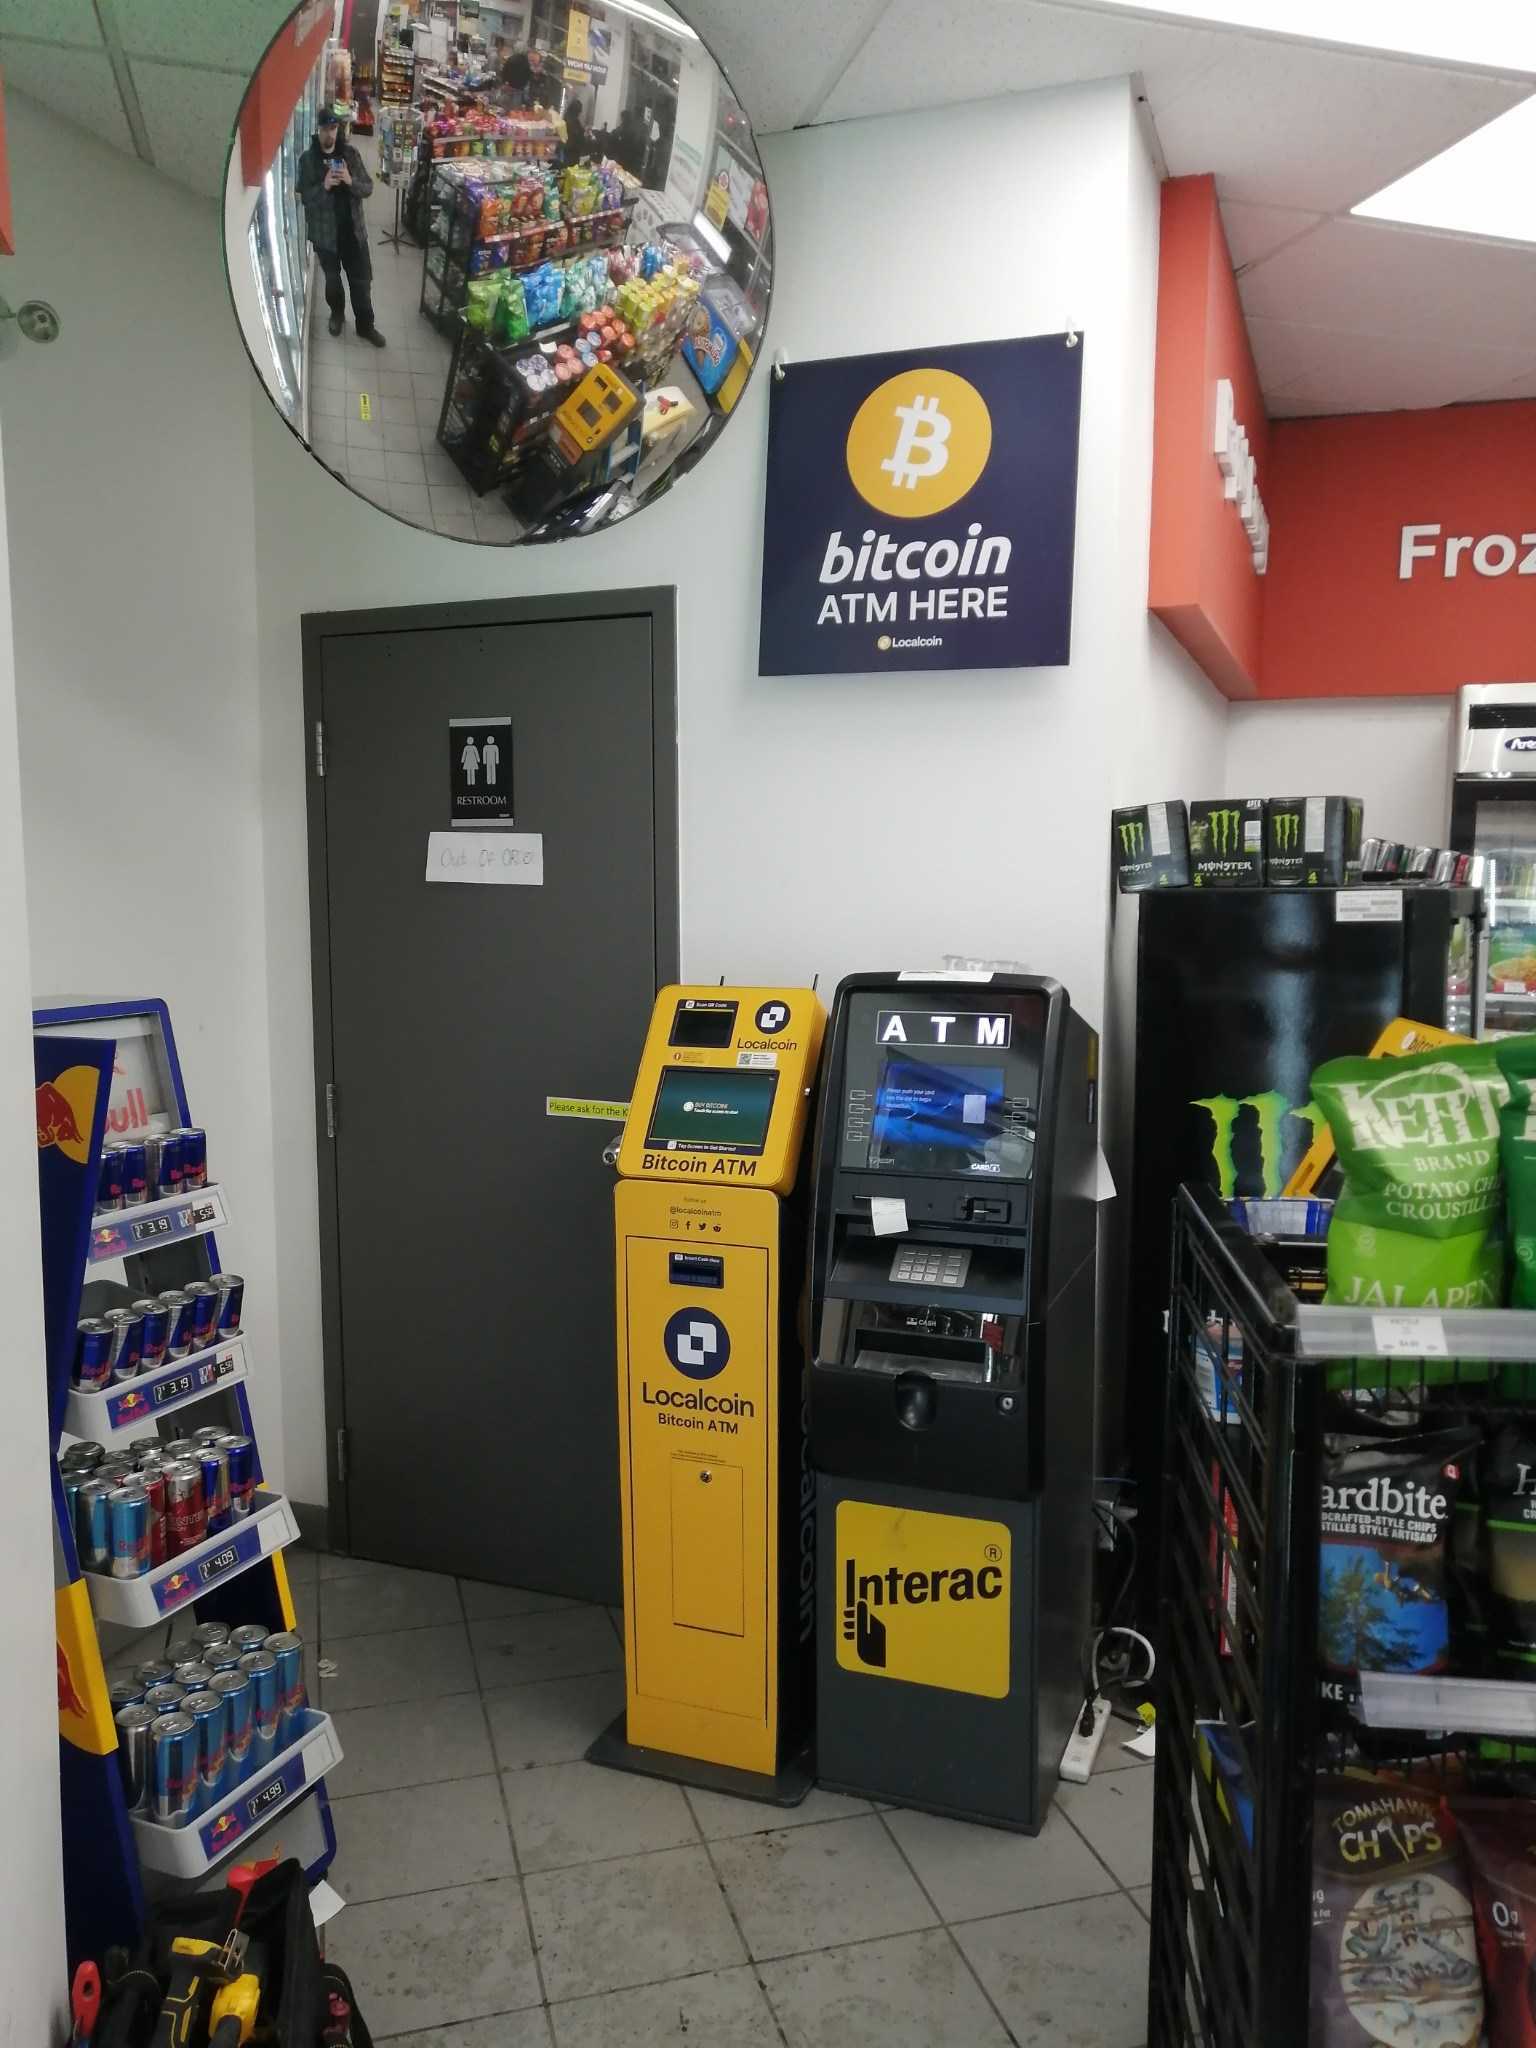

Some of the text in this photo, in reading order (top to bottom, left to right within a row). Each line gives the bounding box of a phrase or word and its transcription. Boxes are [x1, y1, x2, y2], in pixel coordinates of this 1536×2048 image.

[819, 522, 1012, 584] bitcoin
[816, 585, 1009, 625] ATM HERE
[892, 635, 943, 649] Localcoin
[457, 795, 507, 806] RESTROOM
[1198, 861, 1253, 872] MONSTER
[737, 1038, 798, 1051] Localcoin
[549, 1102, 575, 1112] Please
[577, 1105, 590, 1113] ask
[592, 1105, 604, 1114] for
[606, 1107, 620, 1116] the
[641, 1154, 757, 1177] Bitcoin ATM
[1414, 1150, 1490, 1172] BRAND
[1384, 1180, 1471, 1199] POTATO
[641, 1381, 755, 1418] Localcoin
[658, 1412, 739, 1434] Bitcoin ATM
[1359, 1524, 1389, 1537] STYLE
[1407, 1520, 1438, 1533] CHIPS
[846, 1558, 1003, 1608] Interac
